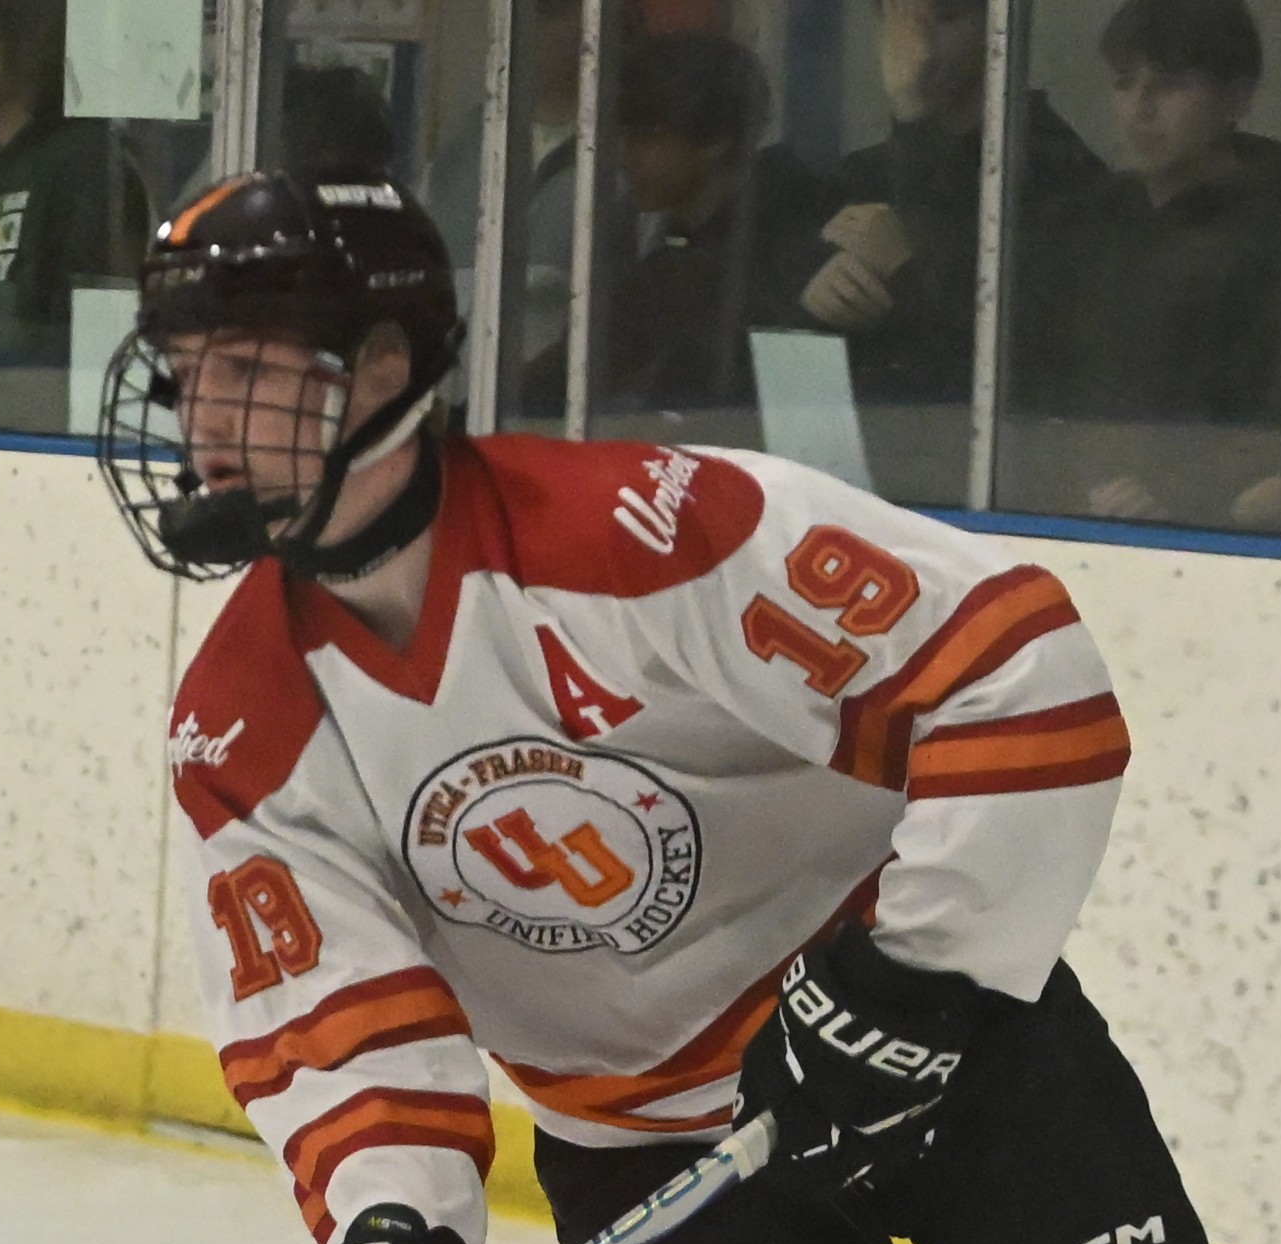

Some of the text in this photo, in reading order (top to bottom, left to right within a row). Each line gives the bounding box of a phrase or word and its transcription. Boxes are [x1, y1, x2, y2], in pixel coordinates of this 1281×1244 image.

[741, 524, 920, 699] 19
[535, 623, 645, 742] A
[208, 855, 323, 1003] 19
[625, 824, 692, 938] HOCKEY
[782, 953, 962, 1084] BAUER
